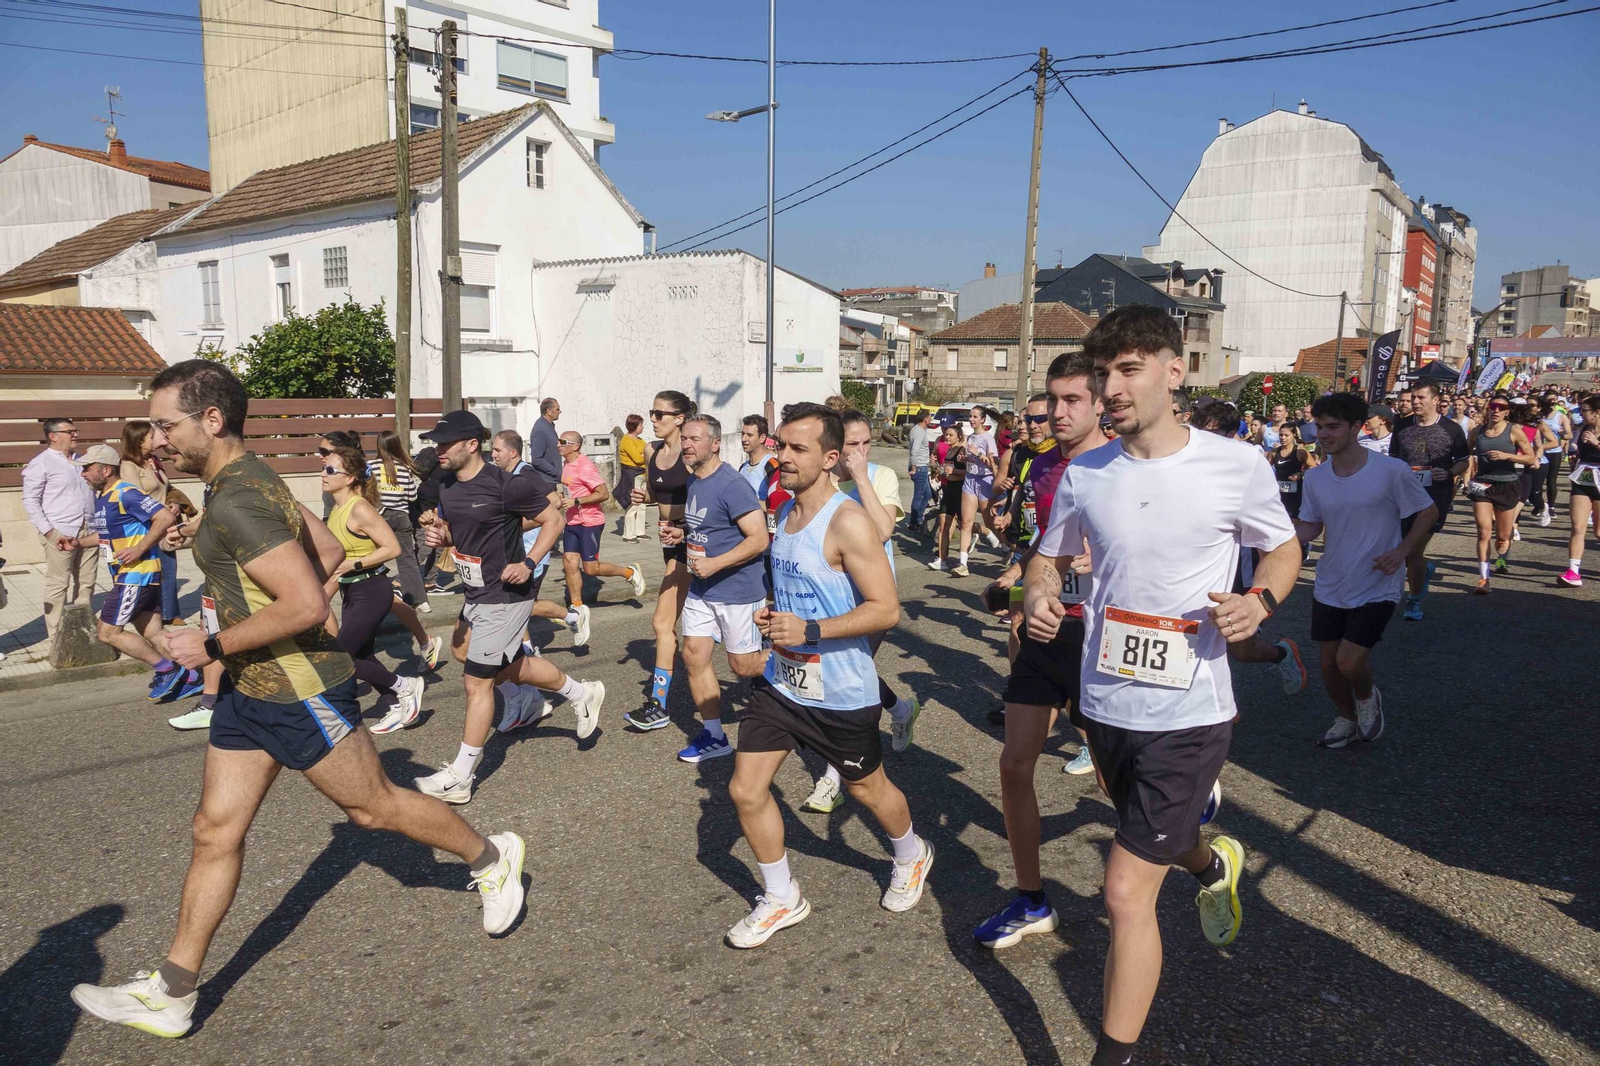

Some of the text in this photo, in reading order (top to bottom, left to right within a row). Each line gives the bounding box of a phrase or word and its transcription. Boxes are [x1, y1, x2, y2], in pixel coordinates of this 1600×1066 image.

[1135, 628, 1160, 638] AARON
[1122, 634, 1169, 671] 813
[780, 660, 808, 690] 682
